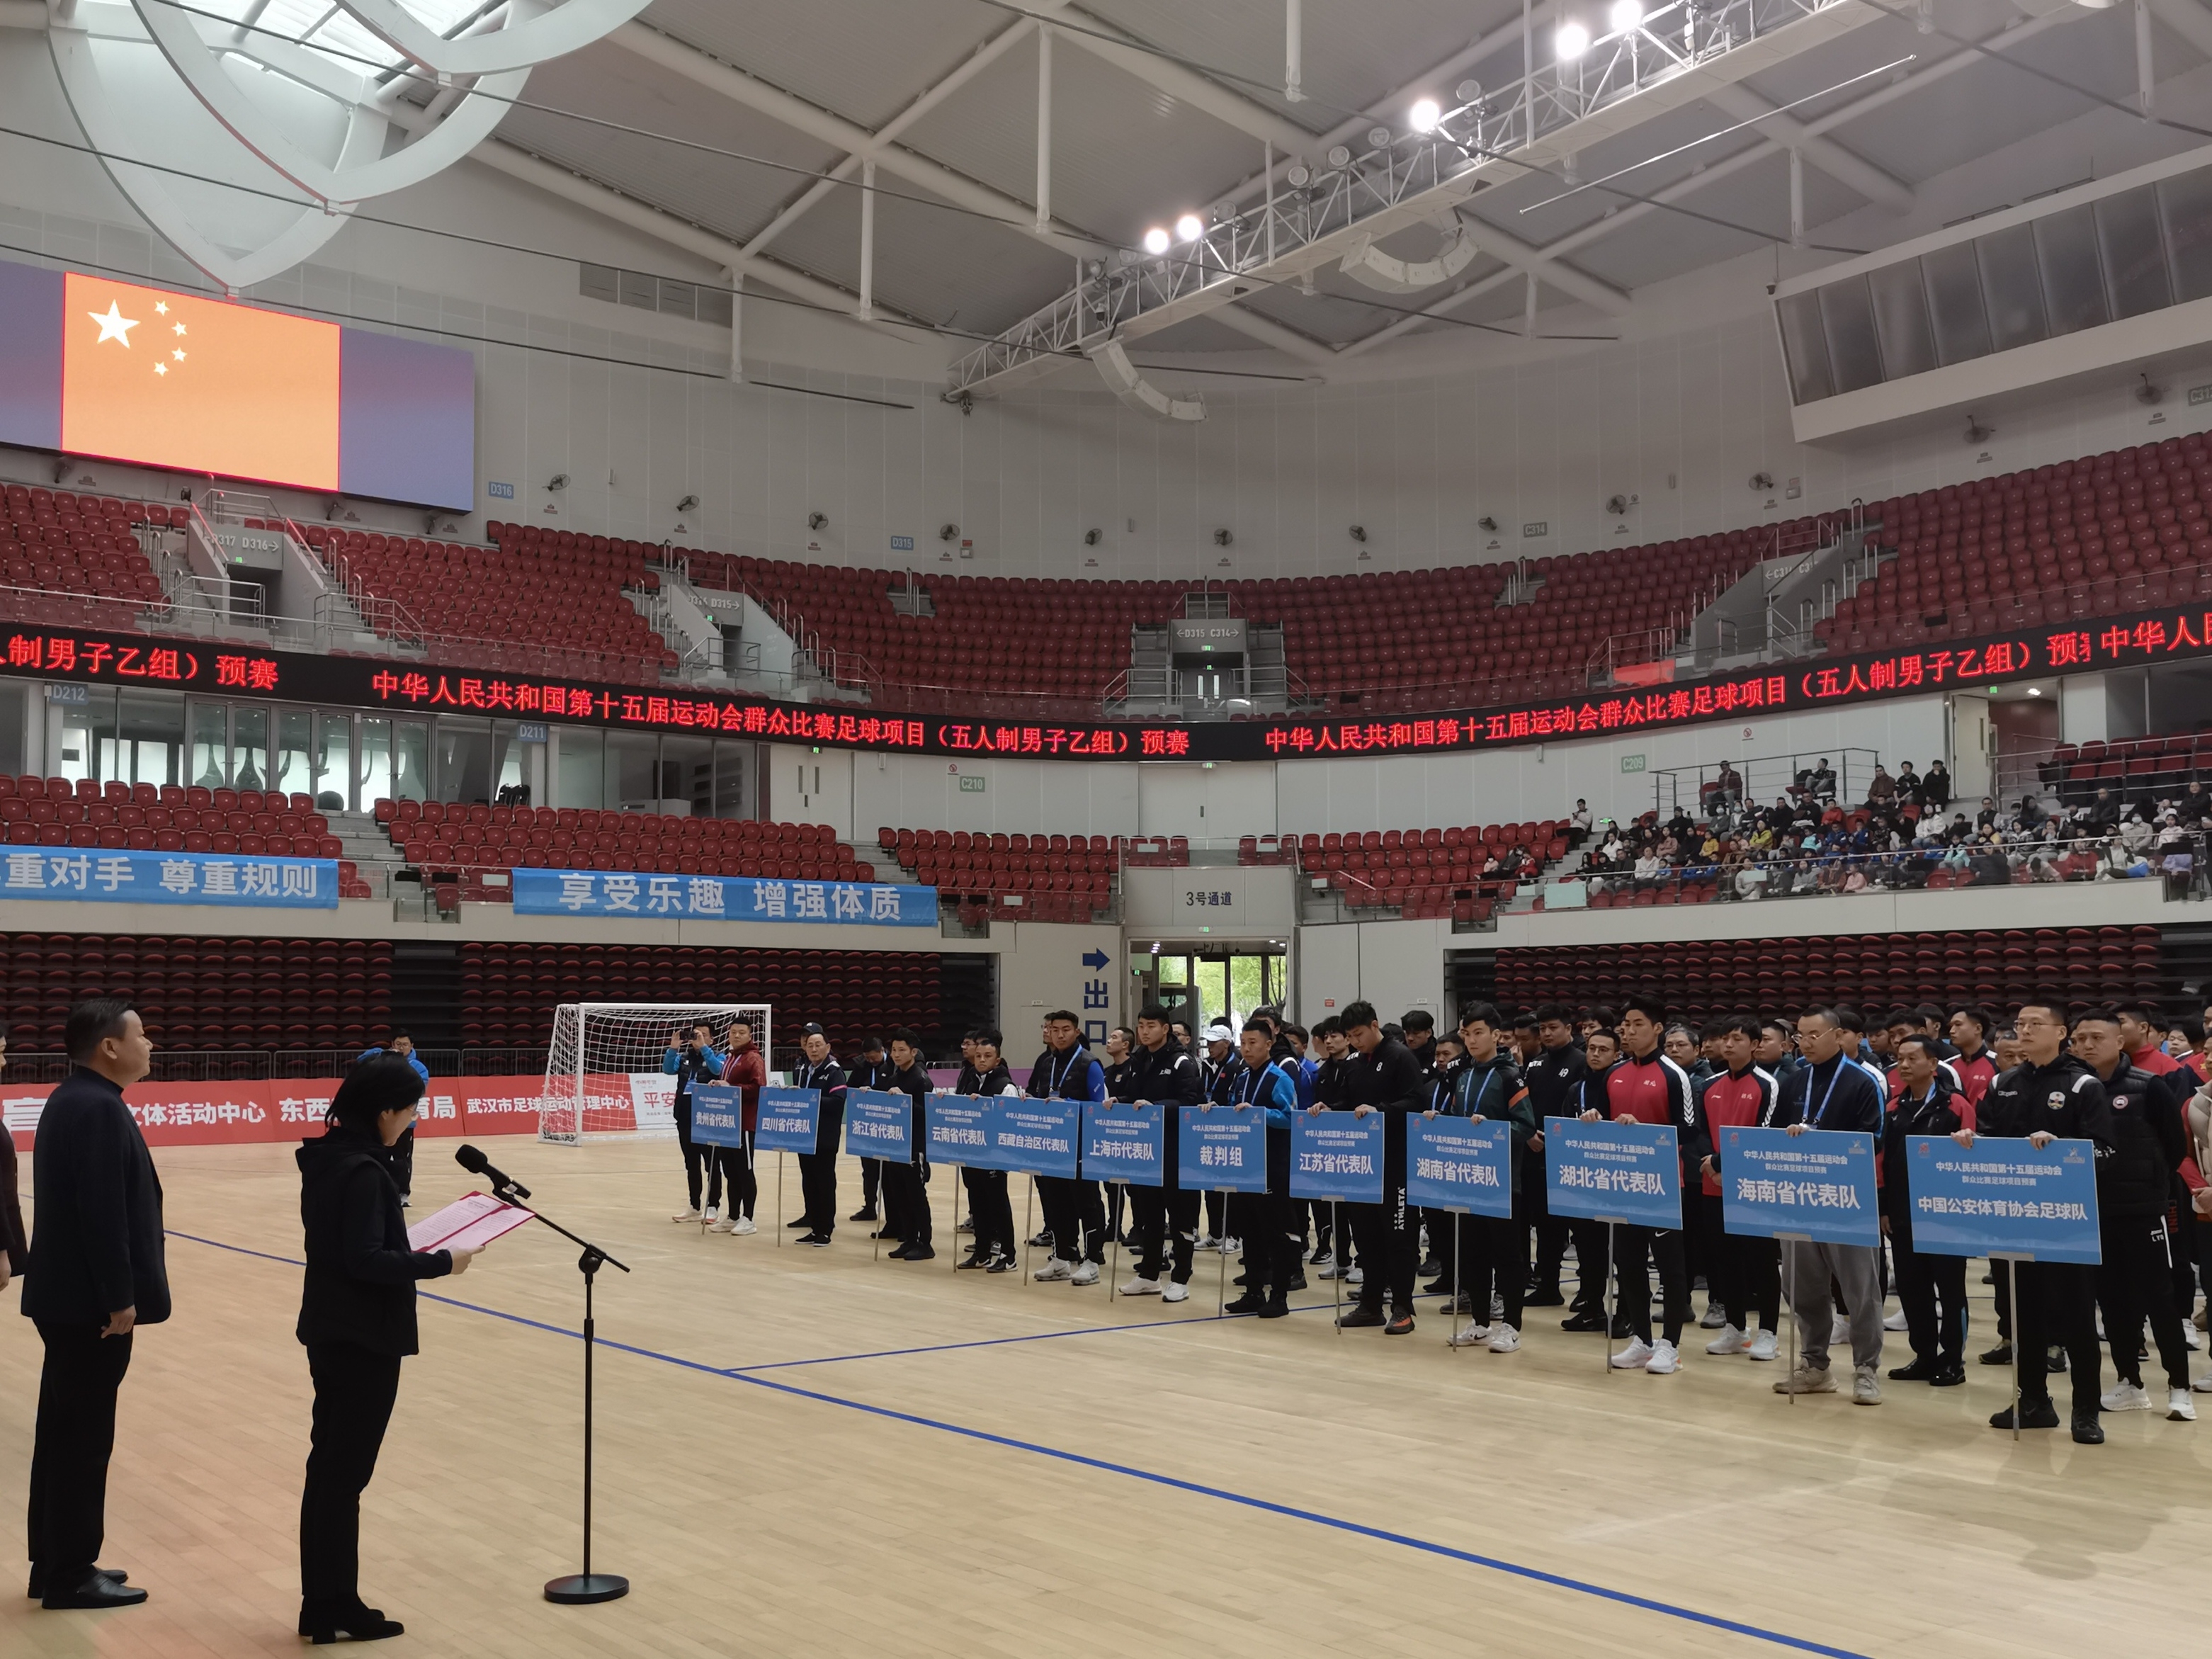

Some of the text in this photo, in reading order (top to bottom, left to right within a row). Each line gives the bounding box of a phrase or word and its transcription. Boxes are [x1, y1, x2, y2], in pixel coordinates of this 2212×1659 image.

[2190, 387, 2212, 402] C31
[490, 483, 513, 497] D316
[1525, 524, 1545, 535] C314
[242, 537, 268, 550] D316
[892, 538, 912, 548] D315
[710, 597, 732, 609] D315
[1185, 628, 1230, 638] D315 C314
[0, 634, 278, 690] 制男子乙组）预赛
[53, 684, 85, 701] D212
[519, 725, 545, 740] D211
[1623, 757, 1644, 771] C209
[961, 778, 983, 791] C210
[5, 853, 318, 899] 重对手 尊重规则
[557, 873, 901, 921] 享受乐趣 增强体质
[1186, 890, 1232, 907] 3号通道
[1084, 978, 1109, 1046] 出口
[1376, 1062, 1383, 1072] 8
[1558, 1068, 1570, 1078] 49
[466, 1094, 630, 1114] 武汉市足球运动管理中心
[696, 1111, 736, 1128] 贵州省代表队
[761, 1116, 811, 1133] 四川省代表队
[852, 1119, 904, 1141] 浙江省代表队
[932, 1126, 987, 1146] 云南省代表队
[998, 1133, 1070, 1154] 西藏自治区代表队
[1089, 1139, 1155, 1161] 上海市代表队
[1565, 1139, 1655, 1156] 中华人民共和国第十五届运动会
[1200, 1145, 1243, 1167] 裁判组
[1299, 1152, 1374, 1175] 江苏省代表队
[1743, 1150, 1849, 1165] 中华人民共和国第十五届运动会
[1416, 1157, 1500, 1188] 湖南省代表队
[1765, 1162, 1827, 1174] 群众比赛足球项目预赛
[1935, 1161, 2063, 1176] 中华人民共和国第十五届运动会
[1558, 1165, 1667, 1196] 湖北省代表队
[1961, 1175, 2037, 1187] 群众比赛足球项目预赛
[1737, 1177, 1861, 1211] 海南省代表队
[1397, 1187, 1406, 1230] ATHLETA
[1917, 1196, 2089, 1221] 中国公安体育协会足球队
